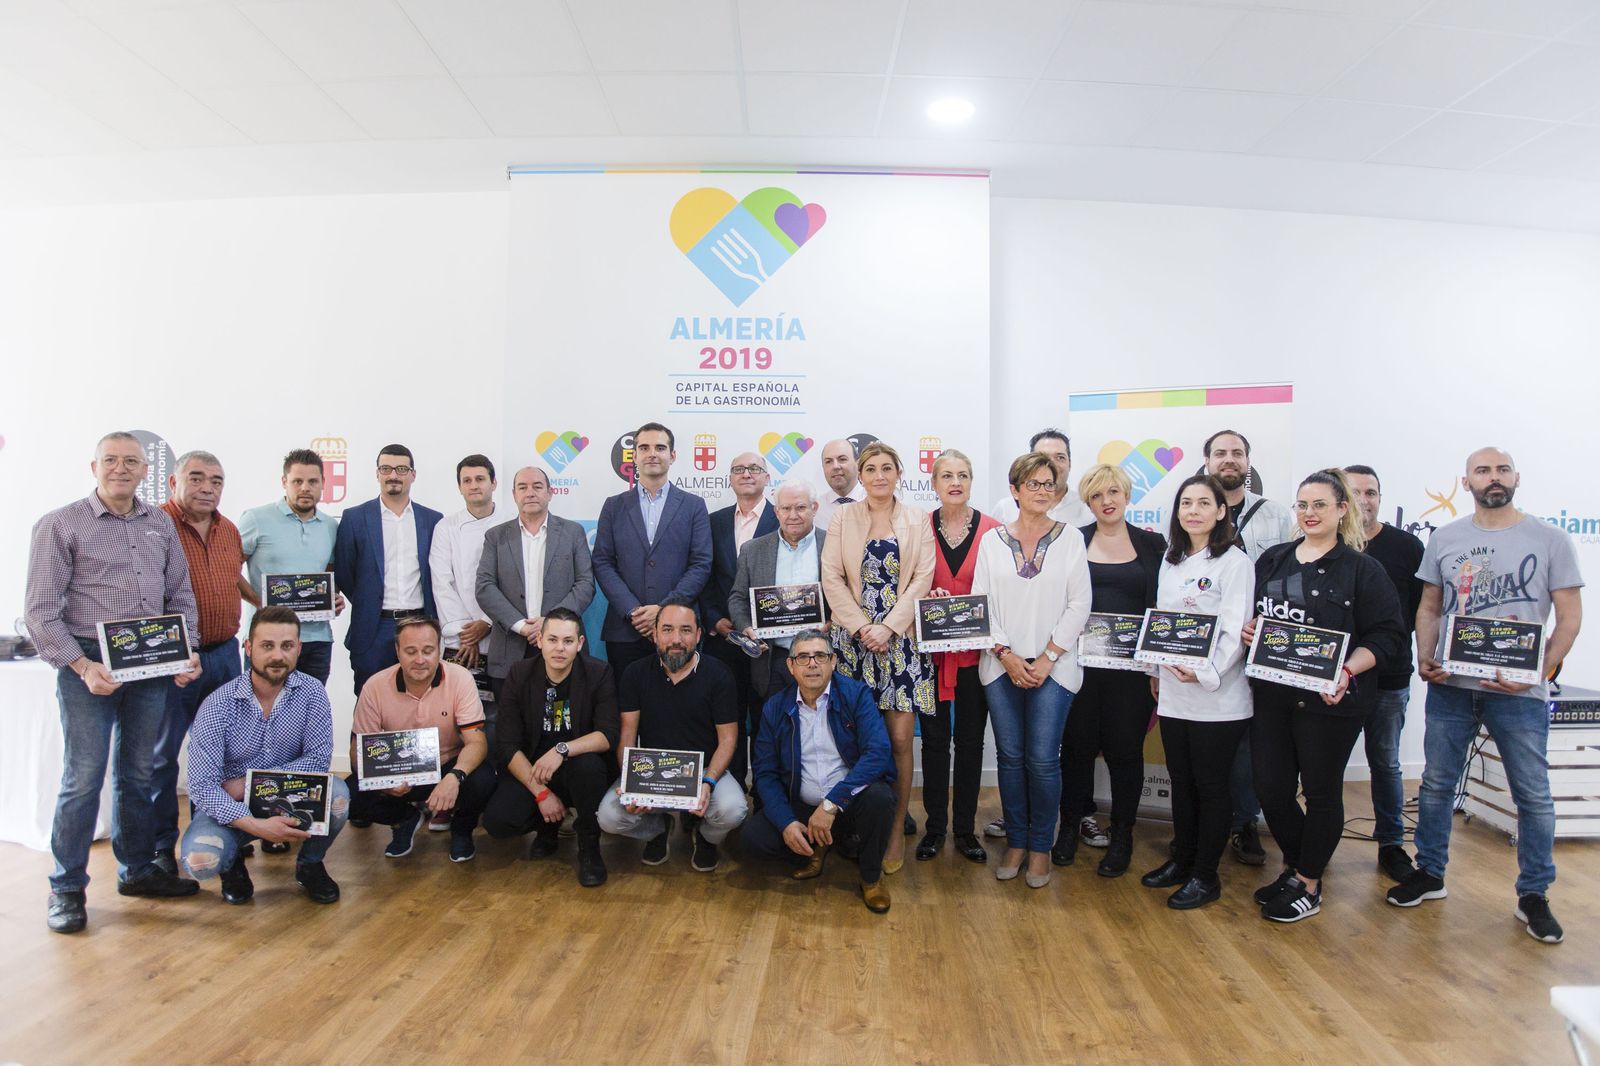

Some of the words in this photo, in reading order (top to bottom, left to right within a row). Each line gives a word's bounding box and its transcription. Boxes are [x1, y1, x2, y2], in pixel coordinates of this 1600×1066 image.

[669, 312, 806, 341] ALMERÍA
[699, 347, 772, 370] 2019
[676, 382, 729, 393] CAPITAL
[732, 381, 800, 393] ESPAÑOLA
[676, 396, 692, 405] DE
[695, 396, 710, 405] LA
[713, 395, 801, 406] GASTRONOMÍA
[156, 440, 167, 505] astronomía
[549, 477, 580, 486] MERÍA
[1455, 553, 1469, 565] THE
[1470, 546, 1488, 557] MAN
[1256, 596, 1305, 623] dida
[1263, 633, 1291, 645] Tapas
[1457, 629, 1486, 641] Tapas
